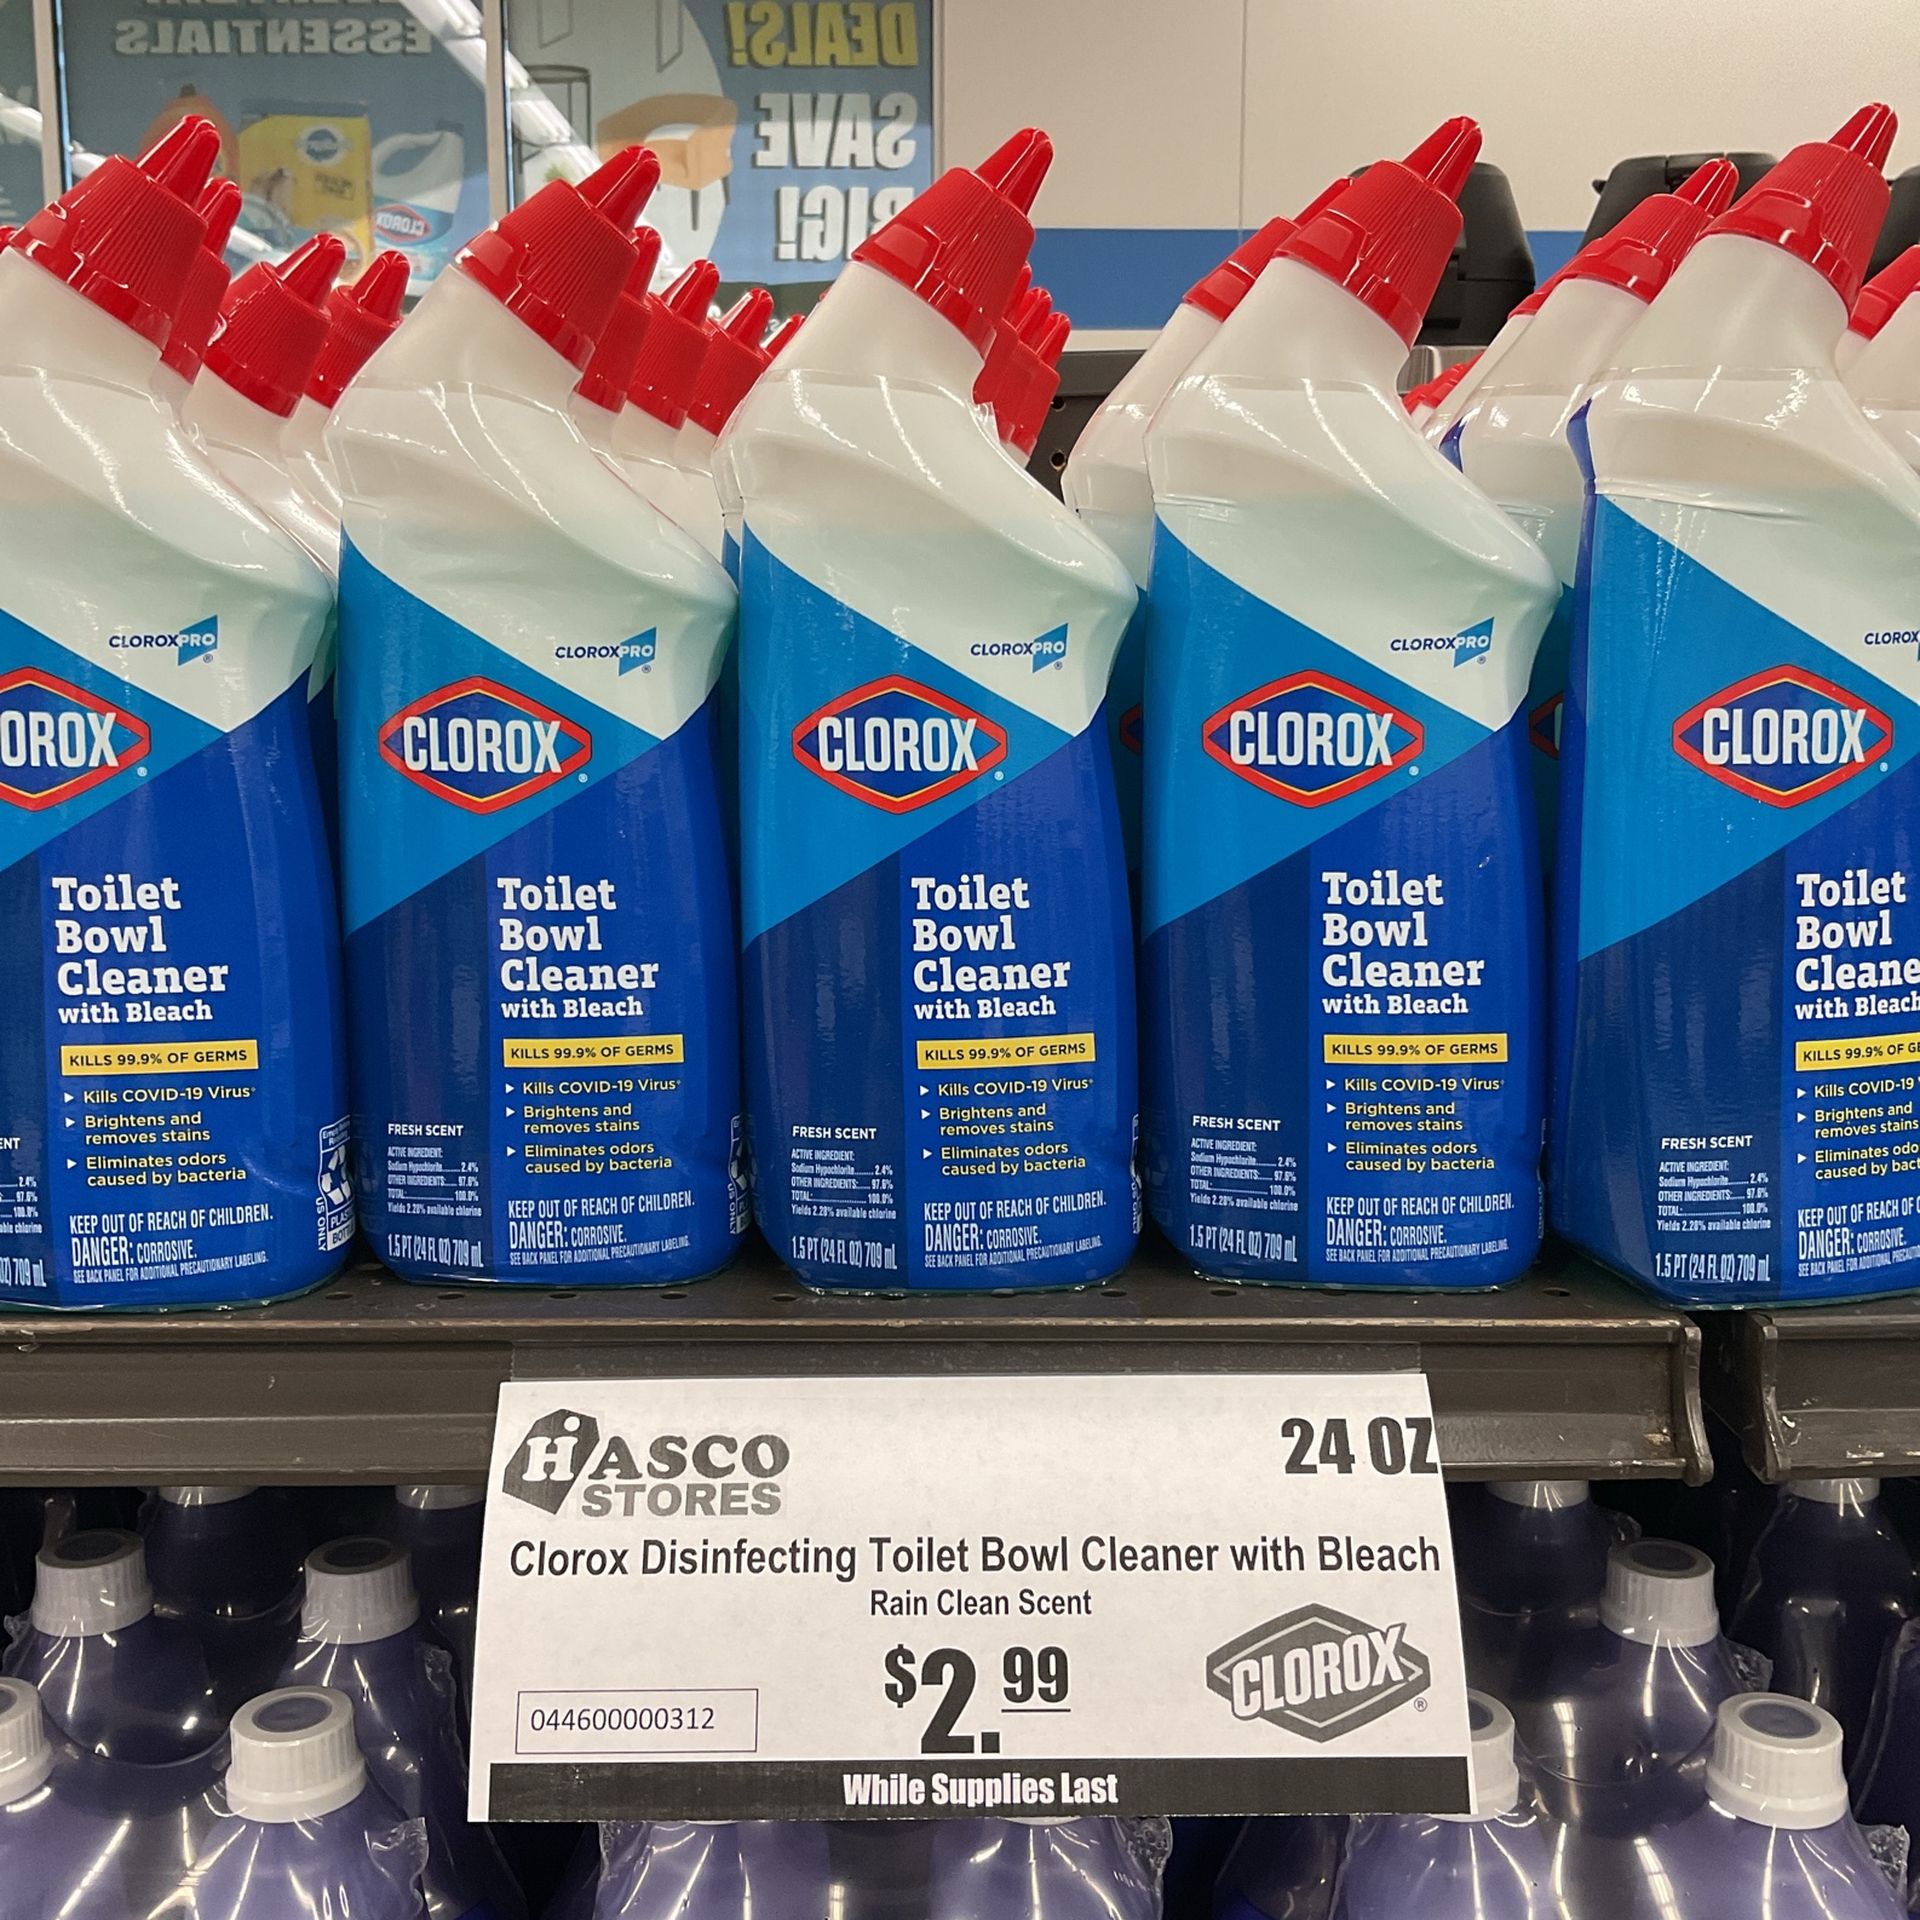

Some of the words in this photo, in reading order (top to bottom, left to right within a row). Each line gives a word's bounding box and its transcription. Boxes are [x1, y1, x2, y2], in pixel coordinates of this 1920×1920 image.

[109, 633, 216, 648] CLOROXPRO
[555, 644, 654, 659] CLOROXPRO
[970, 640, 1065, 656] CLOROXPRO
[1390, 634, 1489, 651] CLOROXPRO
[403, 715, 562, 773] CLOROX
[818, 715, 978, 772] CLOROX
[1229, 710, 1393, 766] CLOROX
[1702, 707, 1867, 765] CLOROX
[52, 873, 181, 911] Toilet
[497, 875, 617, 911] Toilet
[911, 874, 1030, 911] Toilet
[1321, 869, 1444, 906] Toilet
[1795, 868, 1906, 907] Toilet
[55, 916, 167, 954] Bowl
[499, 916, 602, 952] Bowl
[912, 915, 1016, 952] Bowl
[1322, 911, 1428, 947] Bowl
[1795, 909, 1892, 950] Bowl
[58, 959, 229, 996] Cleaner
[500, 956, 660, 992] Cleaner
[913, 956, 1070, 993] Cleaner
[1322, 951, 1485, 988] Cleaner
[59, 1003, 118, 1024] with
[126, 1000, 213, 1022] Bleach
[501, 998, 557, 1019] with
[563, 996, 643, 1018] Bleach
[914, 999, 971, 1020] with
[977, 995, 1056, 1018] Bleach
[1322, 995, 1380, 1015] with
[1387, 993, 1468, 1014] Bleach
[1795, 998, 1849, 1020] with
[69, 1054, 113, 1067] KILLS
[116, 1053, 163, 1066] 99.9%
[167, 1052, 190, 1064] OF
[193, 1049, 248, 1064] GERMS
[511, 1048, 550, 1060] KILLS
[553, 1047, 597, 1060] 99.9%
[600, 1046, 621, 1058] OF
[625, 1043, 674, 1057] GERMS
[925, 1049, 965, 1061] KILLS
[968, 1047, 1012, 1060] 99.9%
[1015, 1045, 1036, 1058] OF
[1039, 1042, 1086, 1057] GERMS
[1332, 1044, 1373, 1056] KILLS
[1376, 1044, 1421, 1056] 99.9%
[1424, 1044, 1446, 1056] OF
[1449, 1042, 1498, 1056] GERMS
[1803, 1048, 1842, 1063] KILLS
[1845, 1045, 1884, 1060] 99.9%
[1886, 1043, 1905, 1056] OF
[83, 1089, 118, 1104] Kills
[122, 1086, 203, 1103] COVID-19
[523, 1081, 555, 1095] Kills
[558, 1079, 634, 1095] COVID-19
[938, 1082, 970, 1097] Kills
[974, 1079, 1048, 1096] COVID-19
[1344, 1078, 1378, 1092] Kills
[1381, 1078, 1458, 1092] COVID-19
[1814, 1083, 1845, 1099] Kills
[1848, 1076, 1915, 1096] COVID-19
[939, 1106, 1014, 1122] Brightens
[1017, 1102, 1046, 1118] and
[1192, 1115, 1234, 1130] FRESH
[1236, 1118, 1281, 1132] SCENT
[1814, 1106, 1885, 1124] Brightens
[1887, 1100, 1913, 1116] and
[388, 1123, 423, 1136] FRESH
[425, 1124, 464, 1137] SCENT
[792, 1125, 832, 1139] FRESH
[834, 1127, 877, 1140] SCENT
[940, 1124, 1006, 1136] removes
[1010, 1119, 1055, 1134] stains
[524, 1144, 606, 1158] Eliminates
[609, 1141, 655, 1156] odors
[941, 1145, 1020, 1160] Eliminates
[1024, 1142, 1069, 1157] odors
[1661, 1137, 1707, 1150] FRESH
[1709, 1134, 1754, 1149] SCENT
[525, 1159, 581, 1174] caused
[585, 1159, 605, 1175] by
[609, 1156, 673, 1172] bacteria
[942, 1161, 996, 1176] caused
[1000, 1160, 1020, 1176] by
[1023, 1155, 1086, 1173] bacteria
[508, 1200, 536, 1219] KEEP
[538, 1199, 561, 1219] OUT
[563, 1198, 579, 1218] OF
[581, 1196, 618, 1216] REACH
[621, 1195, 636, 1214] OF
[638, 1190, 695, 1213] CHILDREN.
[924, 1202, 952, 1222] KEEP
[954, 1201, 977, 1221] OUT
[979, 1200, 994, 1219] OF
[996, 1198, 1033, 1218] REACH
[1035, 1196, 1050, 1215] OF
[1052, 1190, 1107, 1214] CHILDREN.
[924, 1222, 984, 1252] DANGER:
[986, 1225, 1042, 1250] CORROSIVE.
[71, 1236, 134, 1268] DANGER:
[136, 1239, 198, 1265] CORROSIVE.
[1281, 1417, 1355, 1475] 24
[1367, 1416, 1439, 1475] OZ
[582, 1482, 781, 1518] STORES
[509, 1541, 628, 1577] Clorox
[641, 1537, 856, 1582] Disinfecting
[869, 1537, 969, 1573] Toilet
[982, 1535, 1068, 1572] Bowl
[1082, 1535, 1219, 1572] Cleaner
[1230, 1535, 1305, 1571] with
[1317, 1535, 1441, 1571] Bleach
[870, 1588, 928, 1616] Rain
[936, 1588, 1009, 1616] Clean
[1018, 1588, 1092, 1616] Scent
[1230, 1622, 1408, 1722] CLOROX
[530, 1706, 715, 1731] 044600000312
[843, 1772, 926, 1806] While
[931, 1772, 1054, 1811] Supplies
[1061, 1772, 1119, 1804] Last
